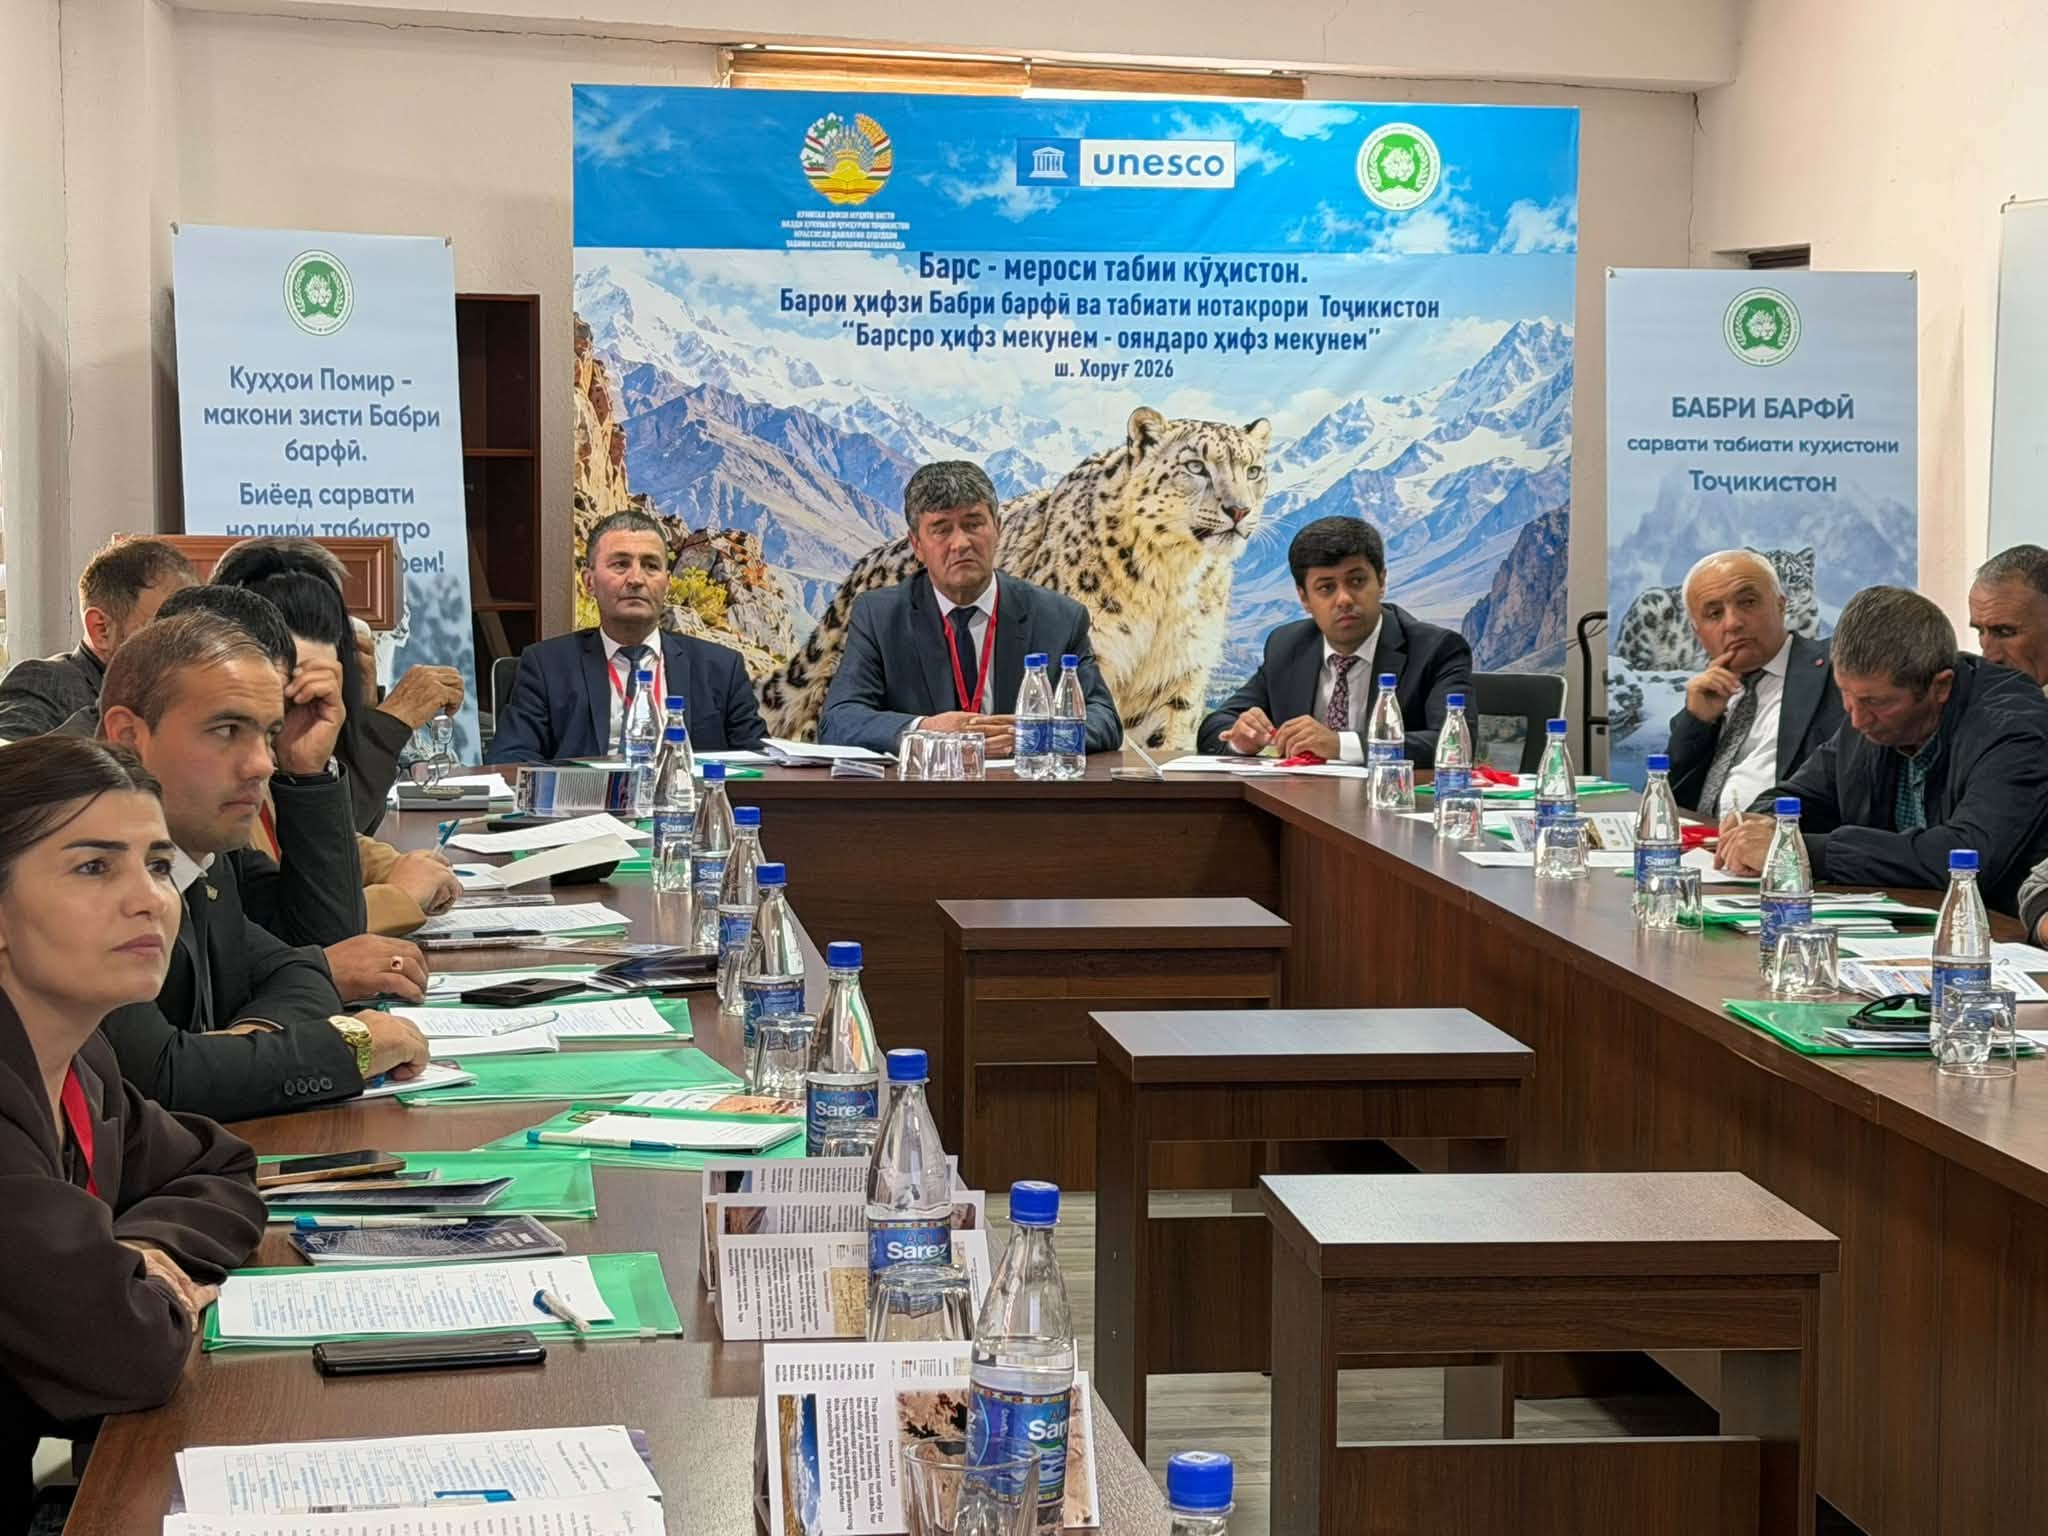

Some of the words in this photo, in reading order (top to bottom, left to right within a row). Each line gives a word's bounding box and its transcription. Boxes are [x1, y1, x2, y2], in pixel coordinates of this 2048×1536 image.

[1093, 153, 1225, 177] unesco
[919, 251, 981, 284] Барс
[1004, 257, 1097, 286] мероси
[1104, 255, 1176, 284] табии
[1183, 256, 1309, 289] кӯҳистон.
[780, 288, 847, 317] Барои
[853, 289, 923, 319] ҳифзи
[930, 290, 995, 319] Бабри
[1001, 291, 1071, 320] барфӣ
[1076, 297, 1101, 316] ва
[1107, 293, 1191, 317] табиати
[1197, 298, 1309, 323] нотакрори
[1319, 294, 1440, 322] Тоҷикистон
[940, 323, 997, 352] ҳифз
[1002, 328, 1098, 353] мекунем
[1117, 330, 1208, 354] ояндаро
[1213, 327, 1268, 355] ҳифз
[229, 365, 313, 395] Куҳҳои
[320, 367, 395, 396] Помир
[1054, 361, 1075, 378] ш.
[1079, 359, 1130, 382] Хоруғ
[1134, 359, 1174, 379] 2026
[203, 407, 293, 425] макони
[299, 409, 363, 426] зисти
[369, 404, 441, 432] Бабри
[1671, 396, 1755, 419] БАБРИ
[1764, 393, 1855, 420] БАРФӢ
[284, 438, 368, 467] барфӣ.
[1627, 437, 1708, 455] сарвати
[1713, 436, 1794, 452] табиати
[1799, 438, 1899, 456] куҳистони
[1688, 469, 1837, 495] Тоҷикистон
[239, 482, 313, 509] Биёед
[318, 486, 415, 510] сарвати
[320, 517, 430, 544] табиатро
[816, 1101, 865, 1118] Sarez
[886, 1240, 948, 1260] Sarez
